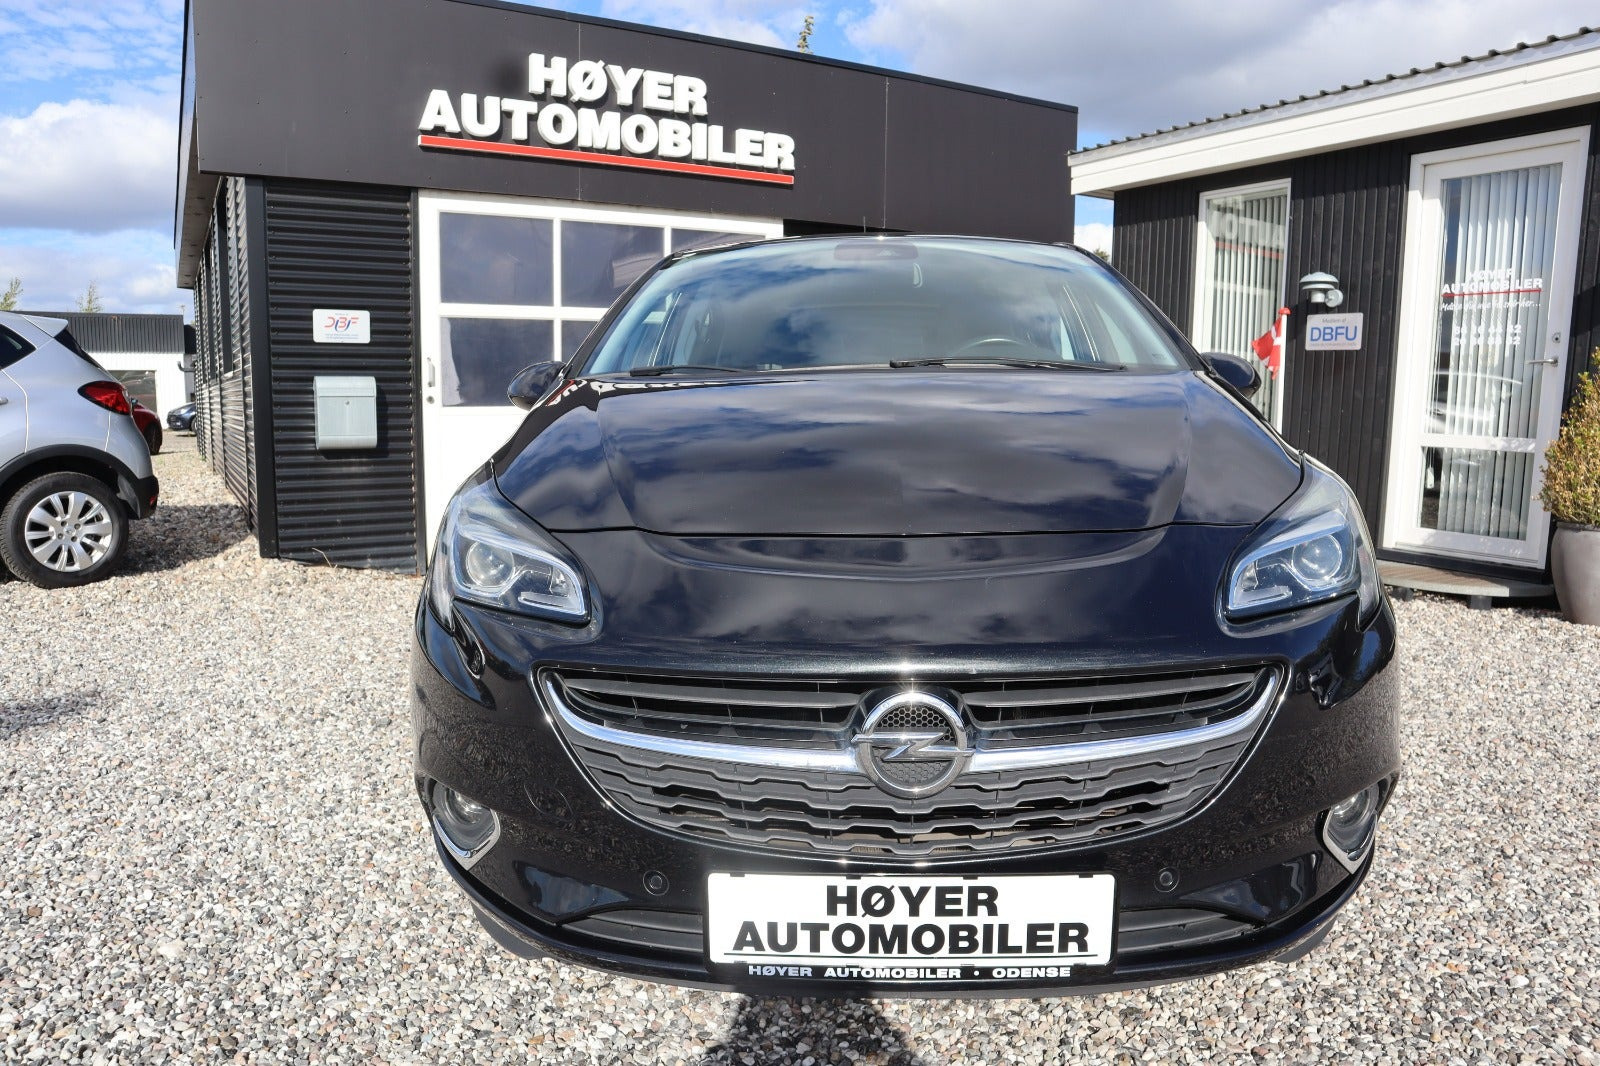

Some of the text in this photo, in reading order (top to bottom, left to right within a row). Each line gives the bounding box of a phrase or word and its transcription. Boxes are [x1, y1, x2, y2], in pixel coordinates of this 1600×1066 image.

[528, 52, 708, 116] HØYER
[418, 89, 795, 171] AUTOMOBILER
[1441, 278, 1543, 293] AUTOMOBILER
[1310, 325, 1357, 342] DBFU
[826, 884, 999, 918] HØYER
[732, 920, 1089, 955] AUTOMOBILER
[748, 965, 1071, 979] HØYER AUTOMOBILER ODENSE
